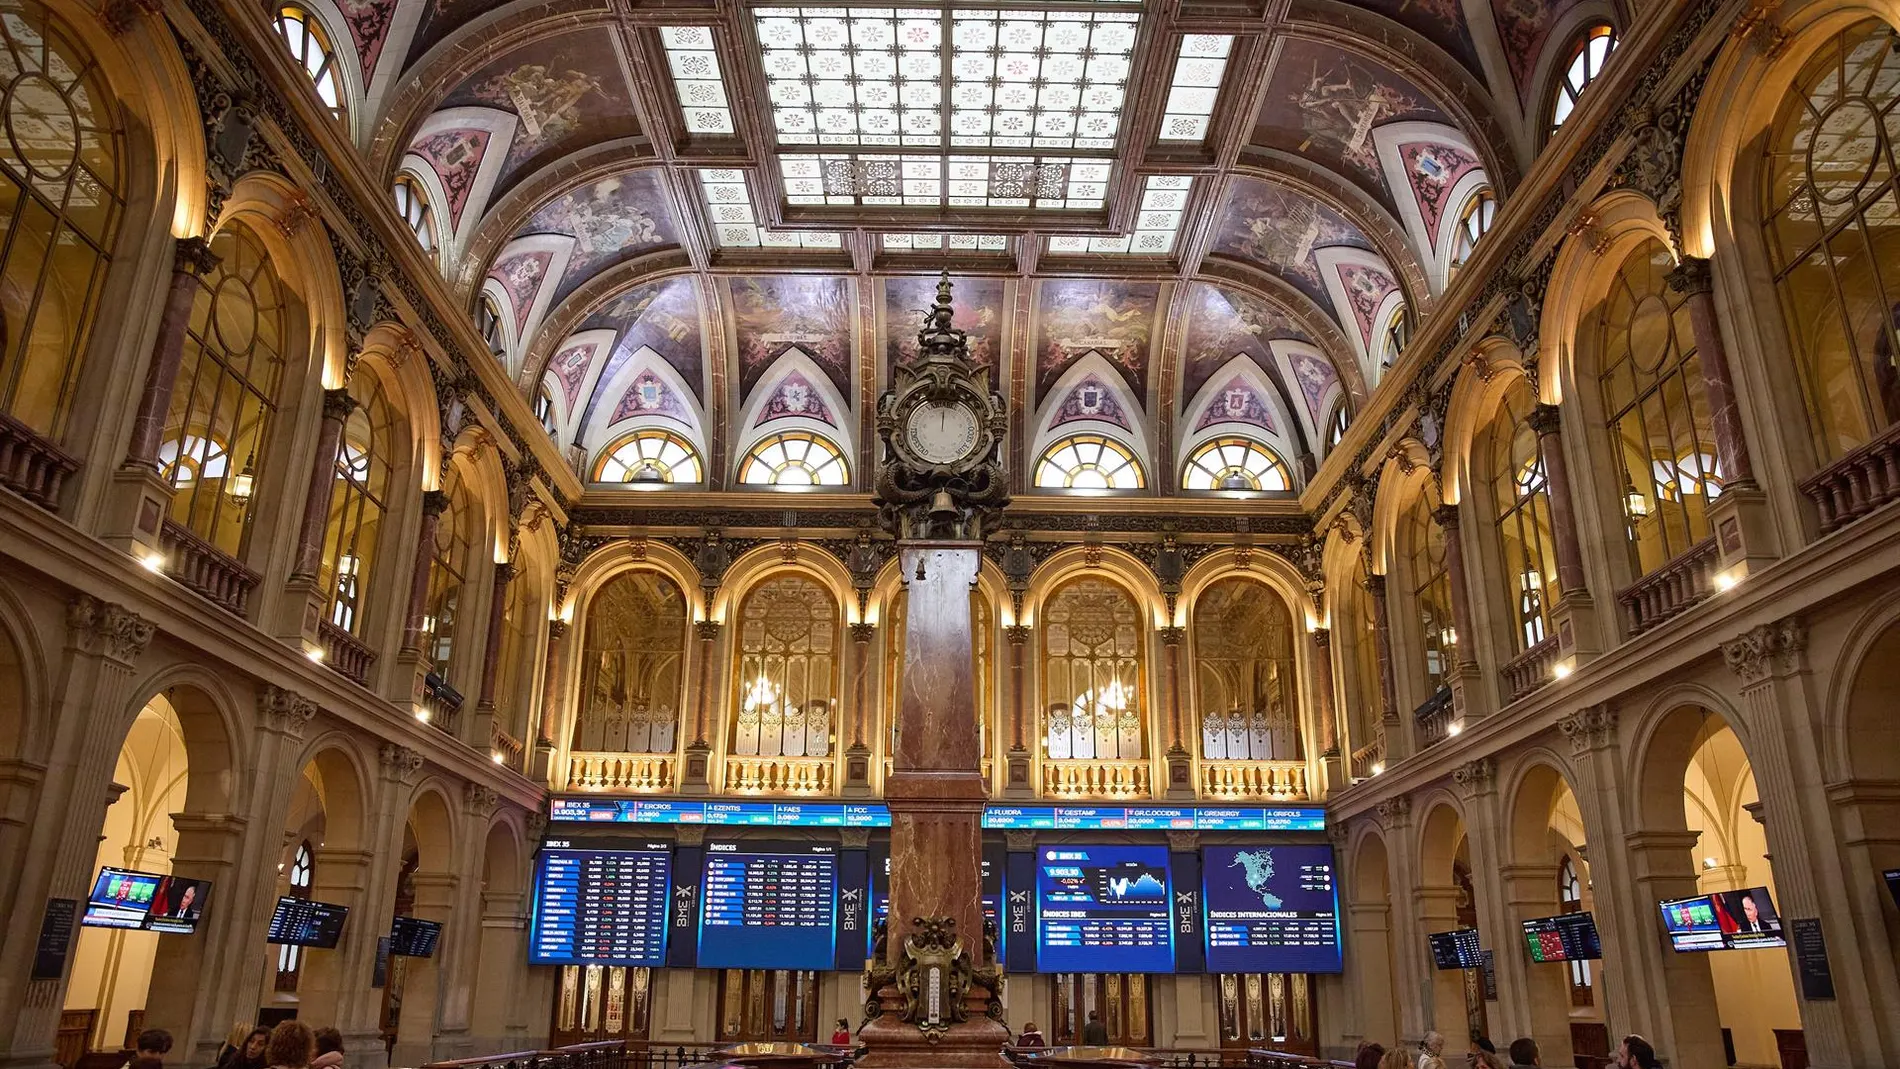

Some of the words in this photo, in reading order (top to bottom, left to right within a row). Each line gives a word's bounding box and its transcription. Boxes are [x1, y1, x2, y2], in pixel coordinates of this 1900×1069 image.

[911, 428, 929, 456] TEMPESTAD
[966, 426, 975, 444] SECO
[562, 840, 570, 848] 35
[710, 842, 737, 851] ÍNDICES
[1049, 868, 1079, 876] 9.903,30
[676, 900, 689, 927] BME
[844, 903, 855, 930] BME
[1013, 905, 1024, 932] BME
[1043, 909, 1070, 918] ÍNDICES
[1180, 906, 1191, 933] BME
[1210, 910, 1237, 918] ÍNDICES
[1238, 910, 1298, 918] INTERNACIONALES
